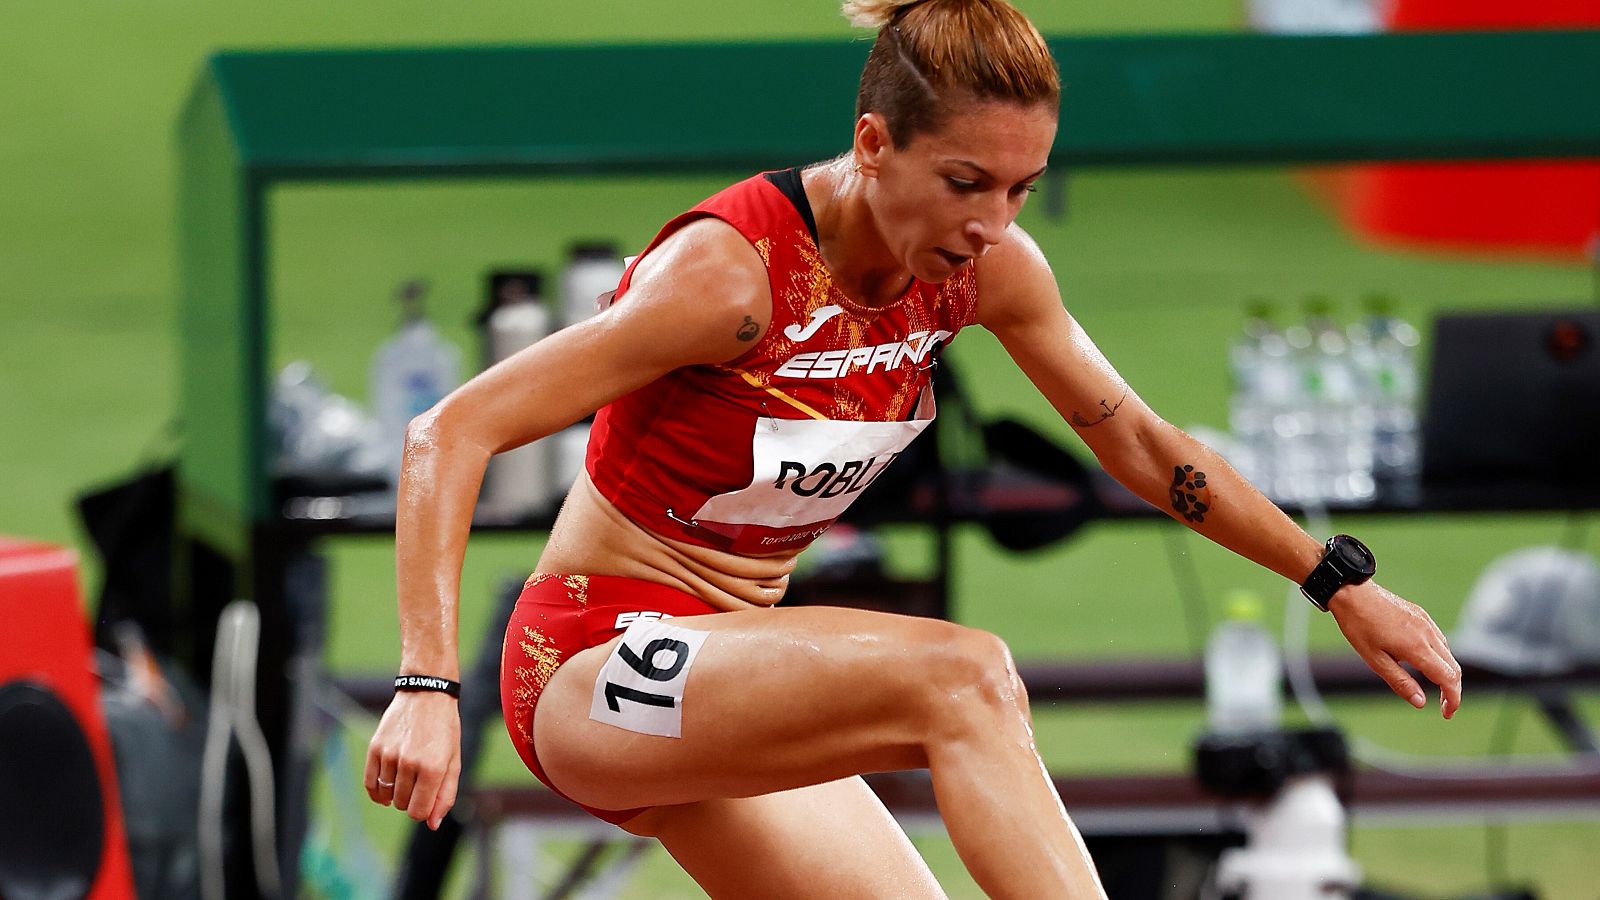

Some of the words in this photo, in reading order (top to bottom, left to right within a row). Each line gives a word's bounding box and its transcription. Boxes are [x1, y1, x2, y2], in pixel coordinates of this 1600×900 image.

[773, 452, 900, 498] ROBL
[409, 676, 449, 690] ALWAYS
[604, 637, 690, 714] 16
